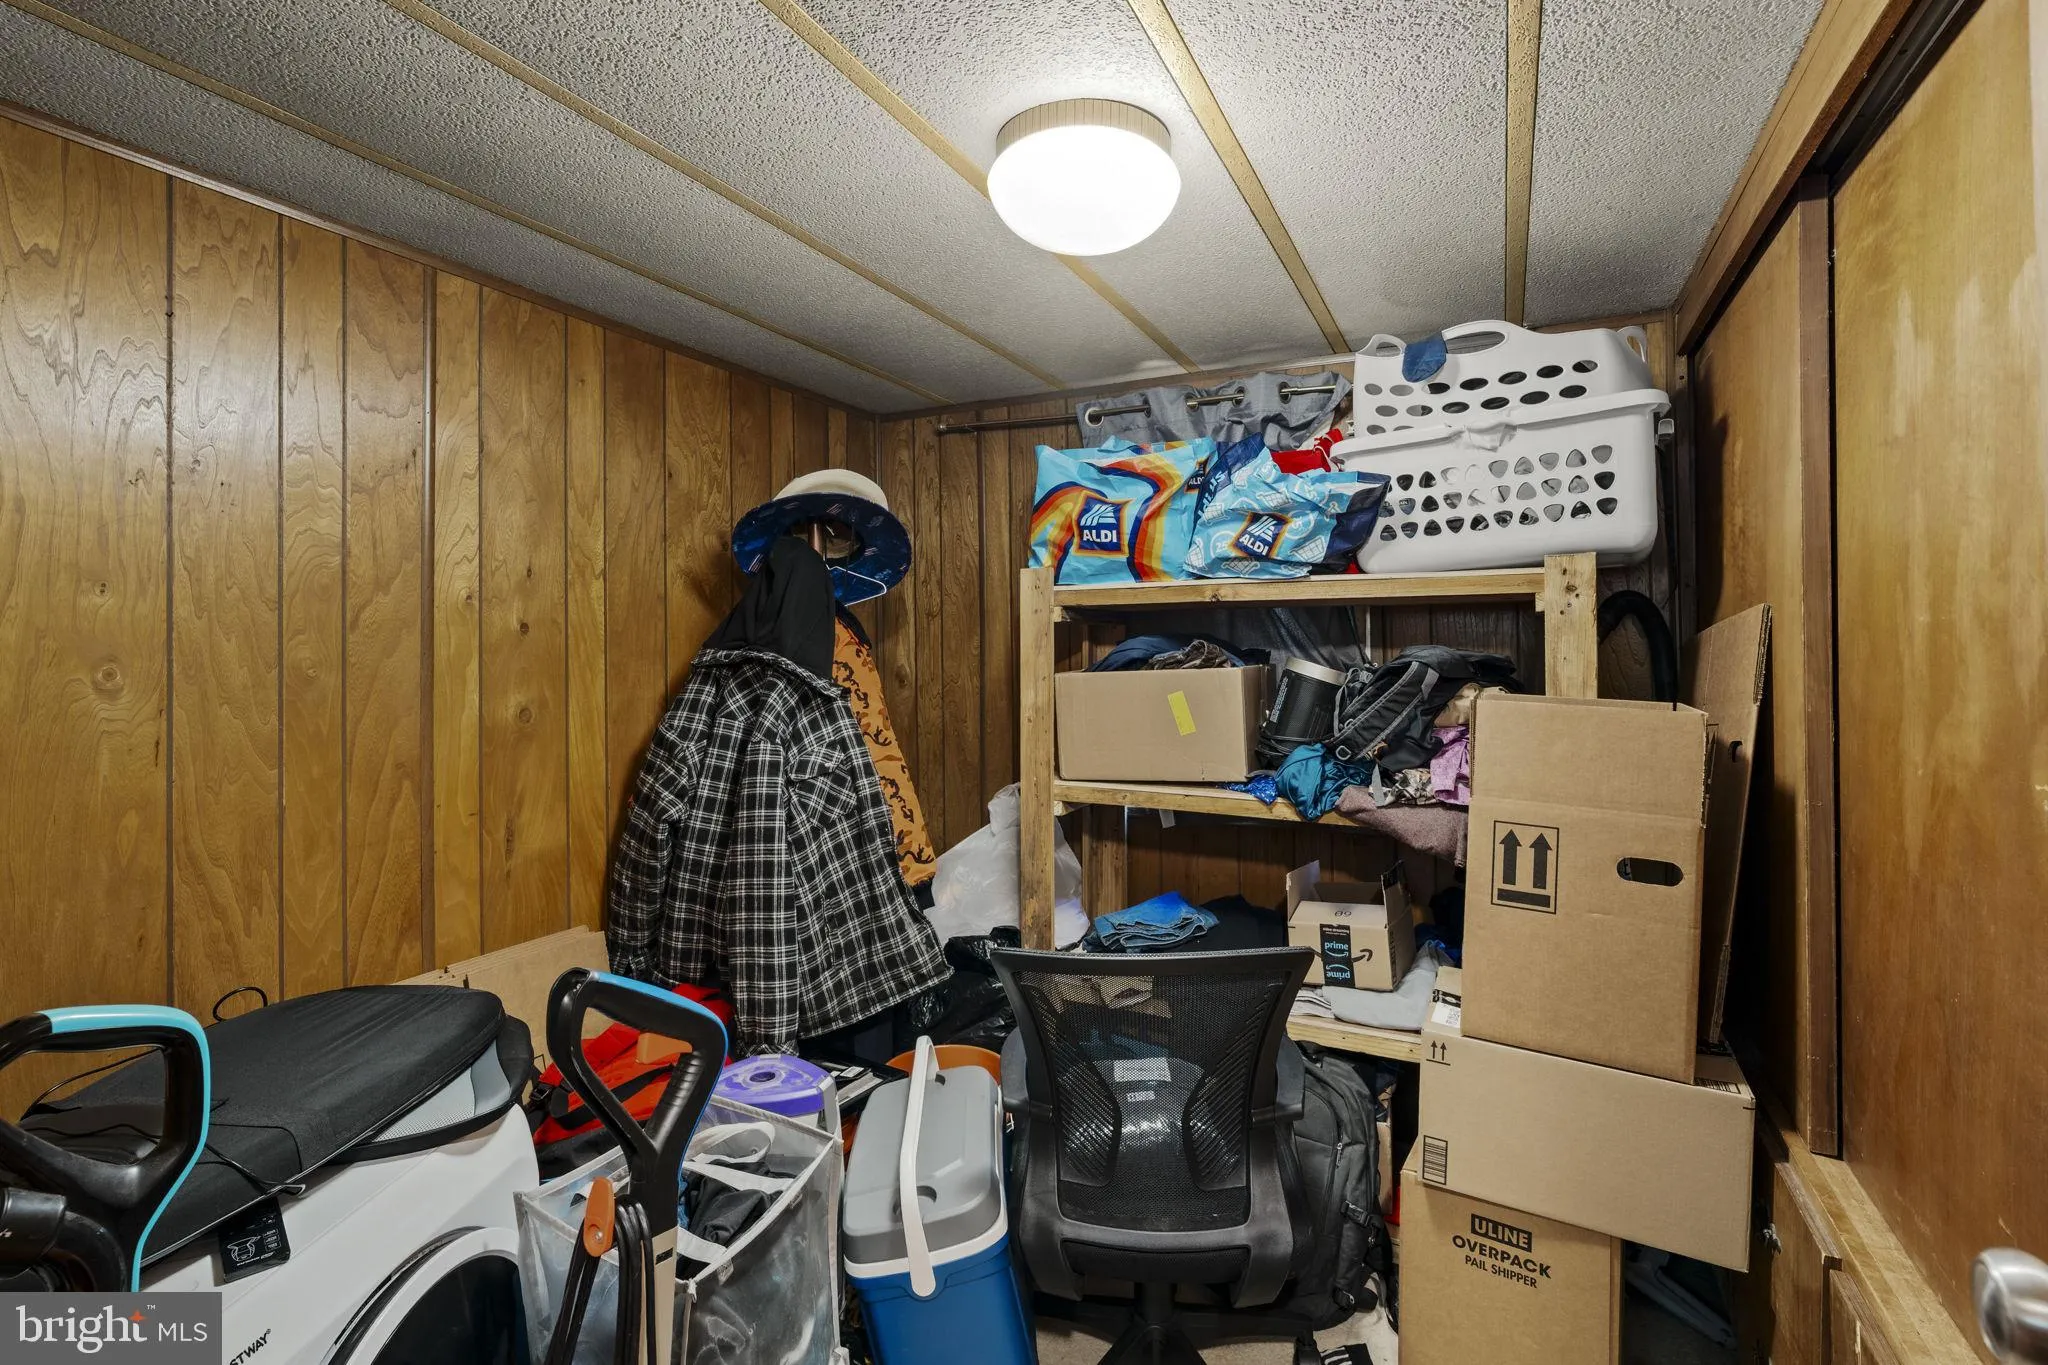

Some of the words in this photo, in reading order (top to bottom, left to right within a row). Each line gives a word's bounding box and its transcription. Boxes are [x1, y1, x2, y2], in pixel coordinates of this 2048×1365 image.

[1188, 477, 1205, 486] ALD
[1083, 529, 1118, 543] ALDI
[1239, 534, 1269, 557] ALDI
[1324, 941, 1349, 951] prime
[1326, 971, 1351, 980] prime
[1474, 1218, 1529, 1249] ULINE
[1452, 1235, 1552, 1280] OVERPACK
[1465, 1254, 1488, 1272] PAIL
[1491, 1263, 1538, 1289] SHIPPER
